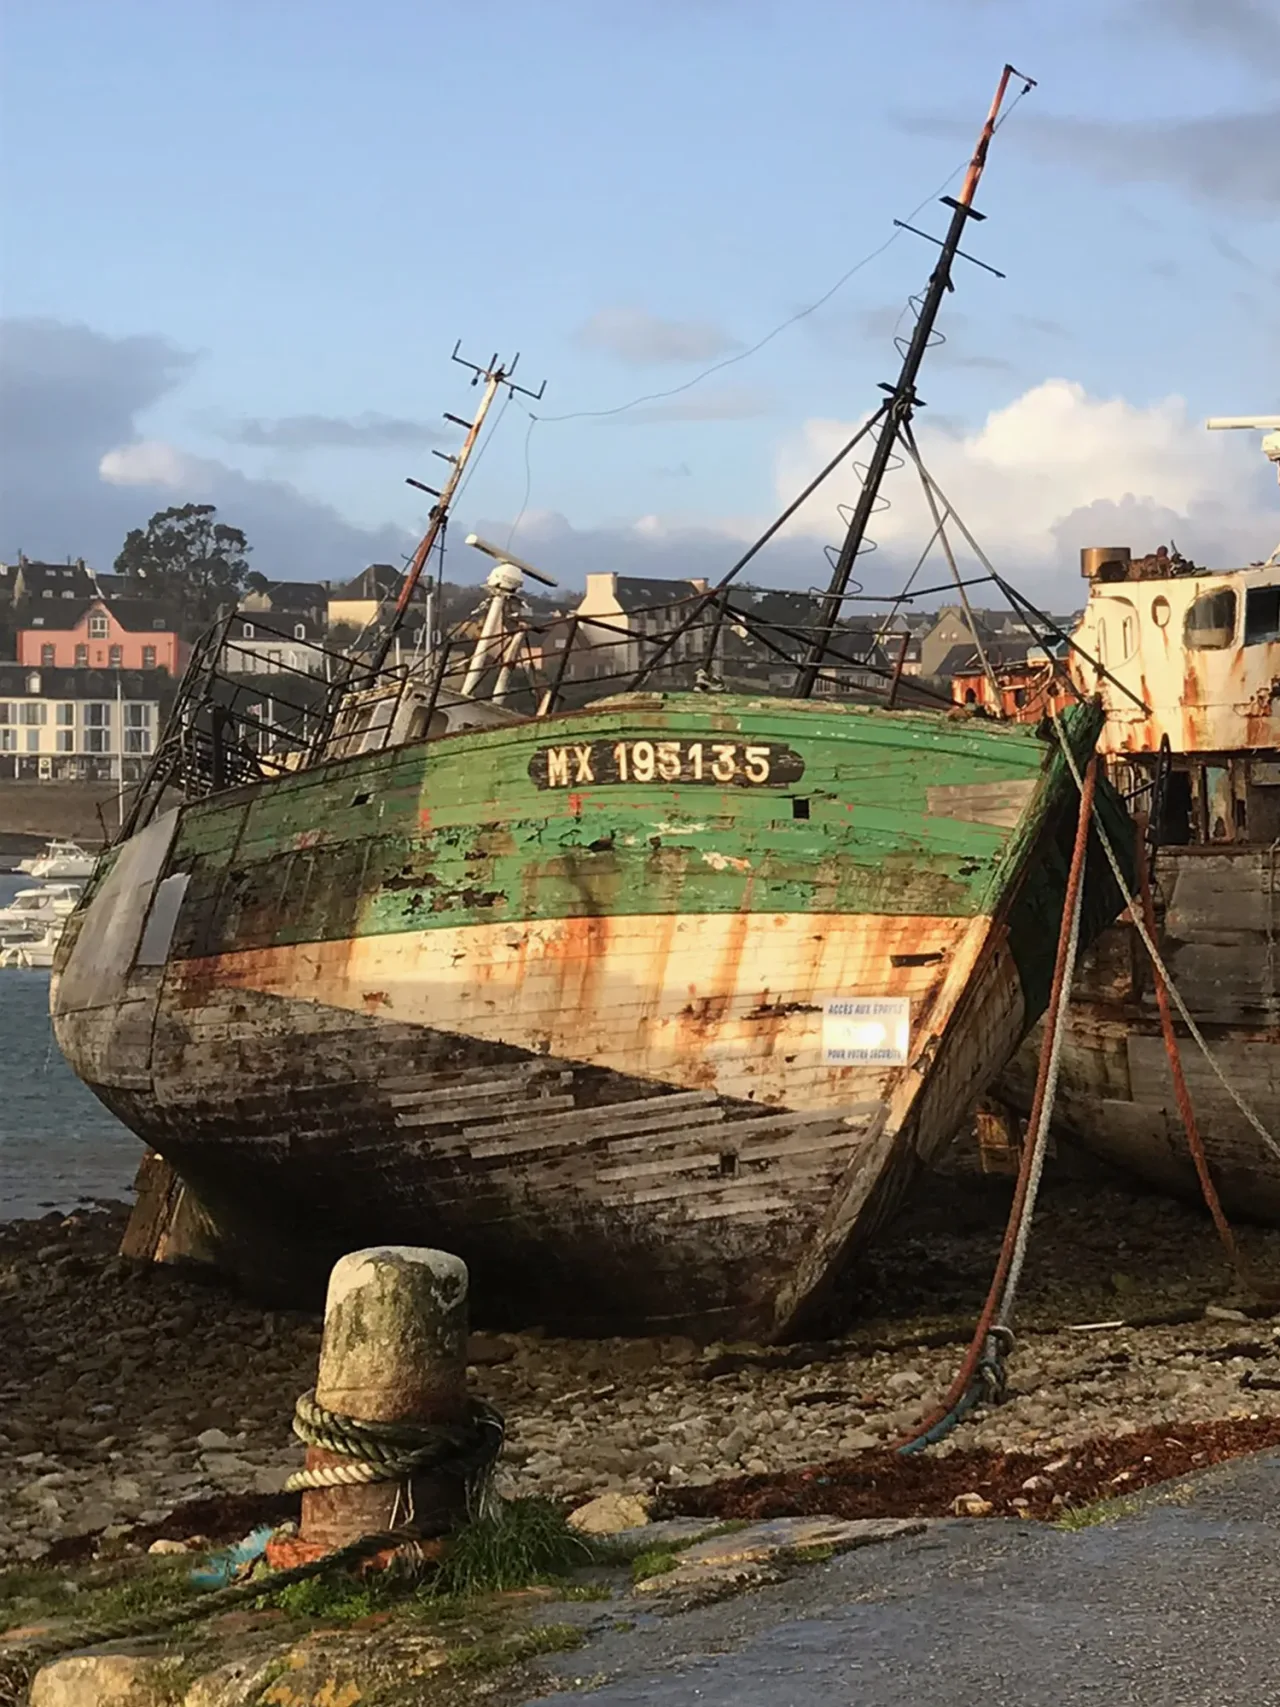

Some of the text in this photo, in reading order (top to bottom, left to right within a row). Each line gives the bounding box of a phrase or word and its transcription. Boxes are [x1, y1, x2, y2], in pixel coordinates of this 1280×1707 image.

[548, 740, 770, 787] MX 195135
[827, 1048, 846, 1059] POUR
